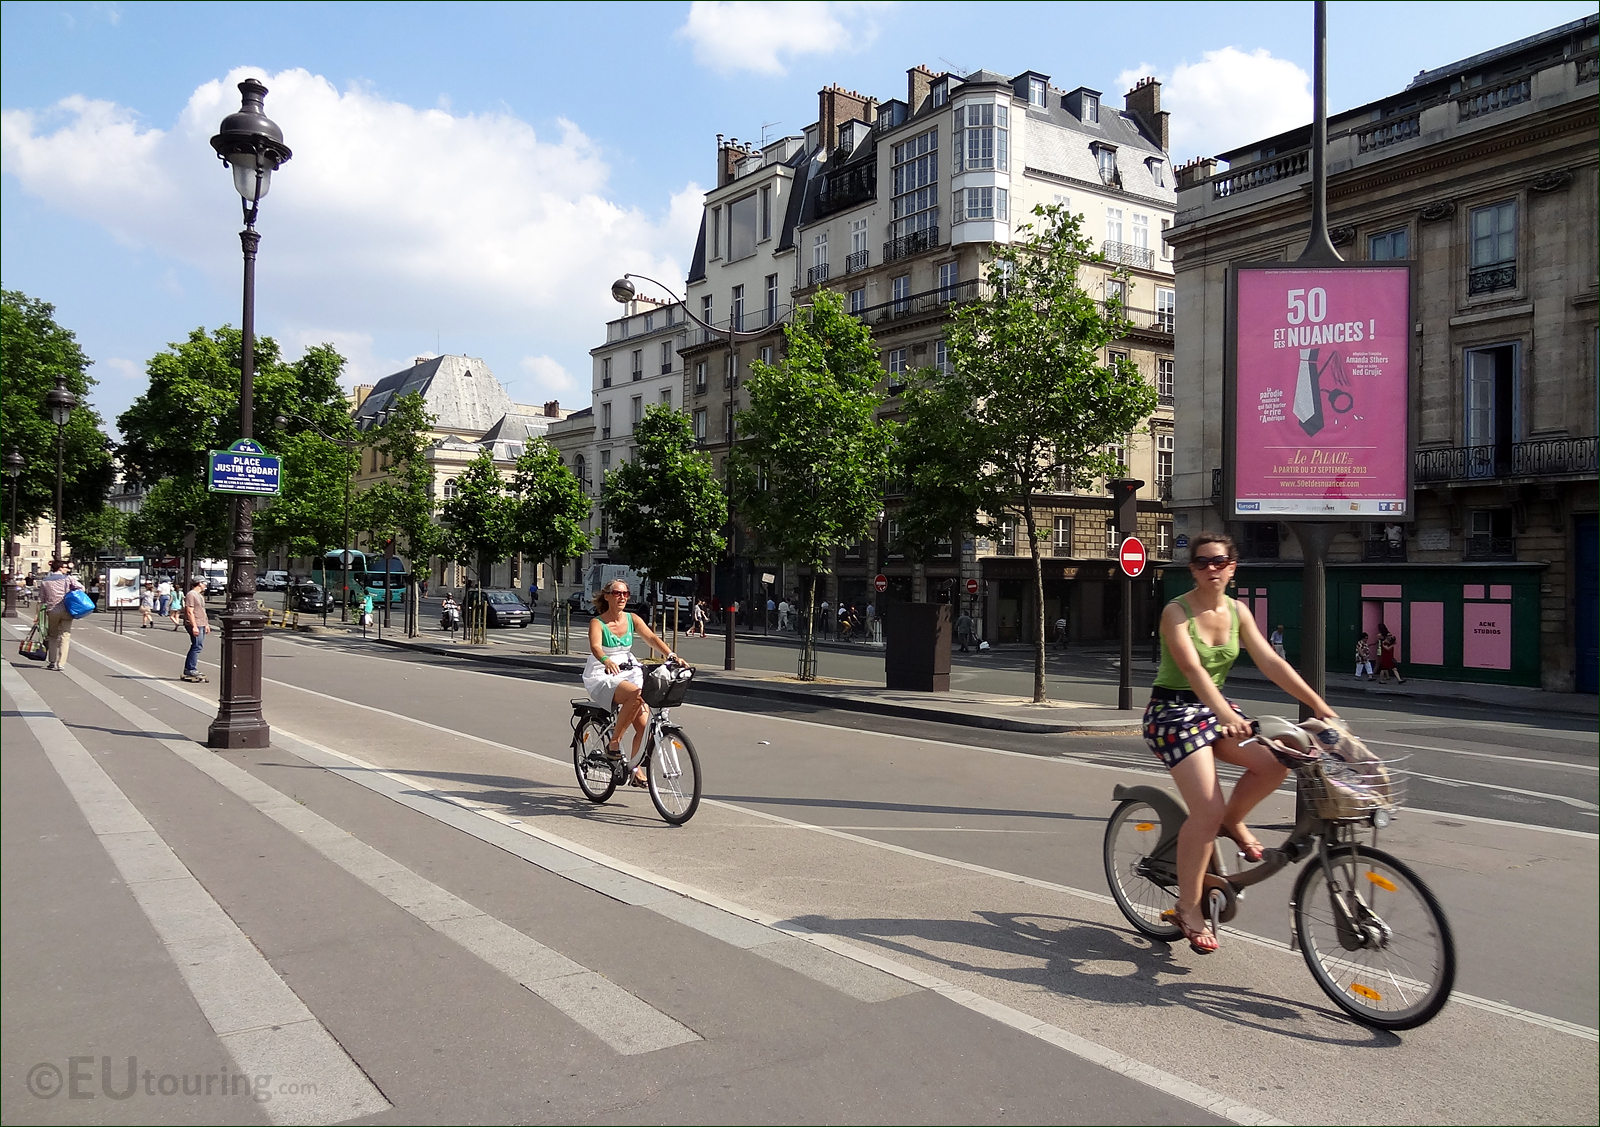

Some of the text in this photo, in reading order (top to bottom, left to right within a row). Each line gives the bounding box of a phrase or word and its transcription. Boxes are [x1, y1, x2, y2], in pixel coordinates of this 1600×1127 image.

[1287, 287, 1327, 325] 50
[1274, 328, 1286, 340] ET
[1287, 319, 1375, 348] NUANCES !
[1273, 340, 1286, 349] DES
[1352, 368, 1364, 376] Ned
[1260, 389, 1283, 400] parodie
[233, 456, 261, 466] PLACE
[1294, 449, 1350, 465] Le PALACE
[214, 463, 244, 473] JUSTIN
[245, 466, 278, 476] GODART
[1278, 466, 1300, 474] PARTIR
[1300, 466, 1309, 474] DU
[1310, 466, 1317, 474] 17
[1317, 466, 1351, 474] SEPTEMBRE
[1352, 466, 1367, 474] 2013
[1280, 480, 1360, 488] www.50etdesnuances.com
